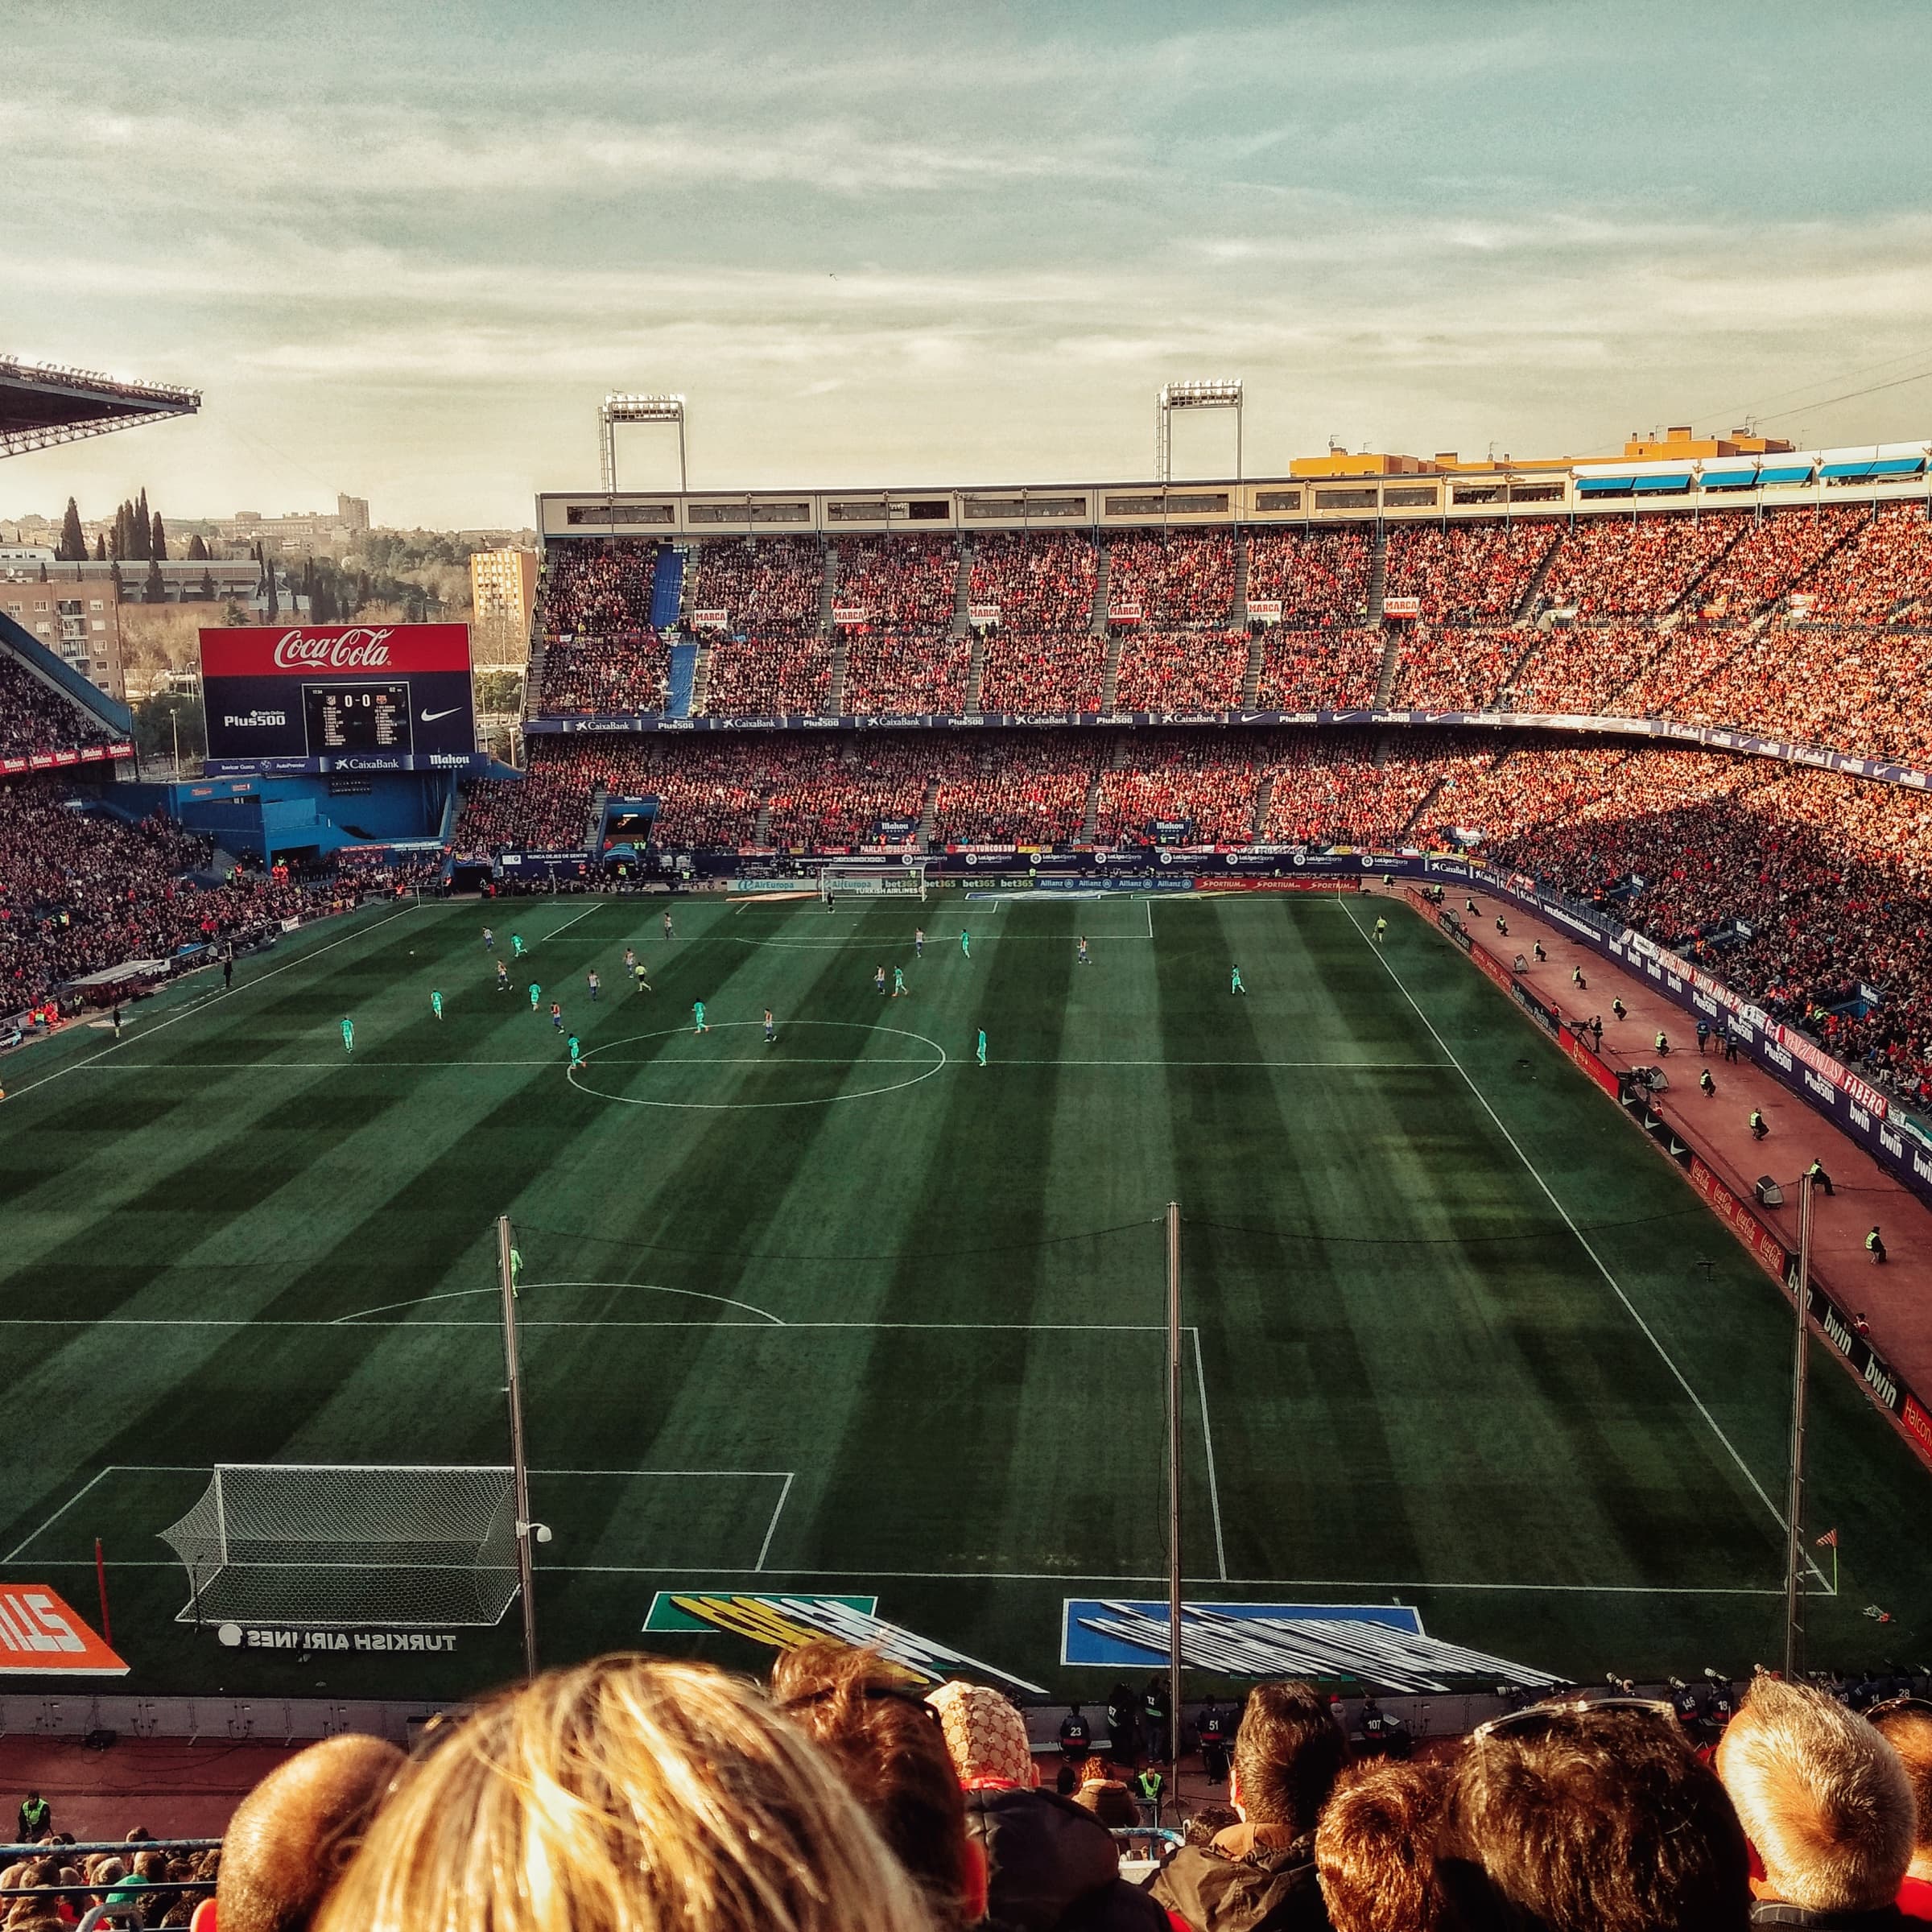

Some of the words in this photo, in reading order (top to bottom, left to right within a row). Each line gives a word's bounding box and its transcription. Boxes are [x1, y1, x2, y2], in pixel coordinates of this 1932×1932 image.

[1249, 604, 1280, 613] MARCA
[1385, 601, 1416, 610] MARCA
[834, 611, 863, 619] MARCA
[970, 609, 999, 617] MARCA
[1110, 607, 1139, 615] MARCA
[696, 613, 725, 621] MARCA
[275, 628, 394, 668] Coca-Cola
[345, 695, 353, 707] 0
[362, 694, 370, 707] 0
[224, 715, 285, 727] Plus500
[735, 718, 776, 728] CaixaBank
[879, 716, 920, 726] CaixaBank
[1027, 715, 1068, 724] CaixaBank
[1174, 713, 1216, 723] CaixaBank
[588, 721, 629, 730] CaixaBank
[429, 753, 470, 765] Mahou
[350, 760, 399, 769] CaixaBank
[882, 822, 909, 830] Mahou
[1693, 991, 1717, 1018] Plus500
[1728, 1014, 1753, 1043] Plus500
[1765, 1040, 1792, 1072] Plus500
[1805, 1069, 1835, 1104] Plus500
[1850, 1100, 1870, 1133] bwin
[1880, 1124, 1903, 1159] bwin
[1913, 1150, 1932, 1185] bwi
[1824, 1305, 1852, 1356] bwin
[1865, 1353, 1897, 1409] bwin
[1209, 1720, 1219, 1730] 51
[1368, 1720, 1381, 1730] 107
[1071, 1727, 1082, 1736] 23
